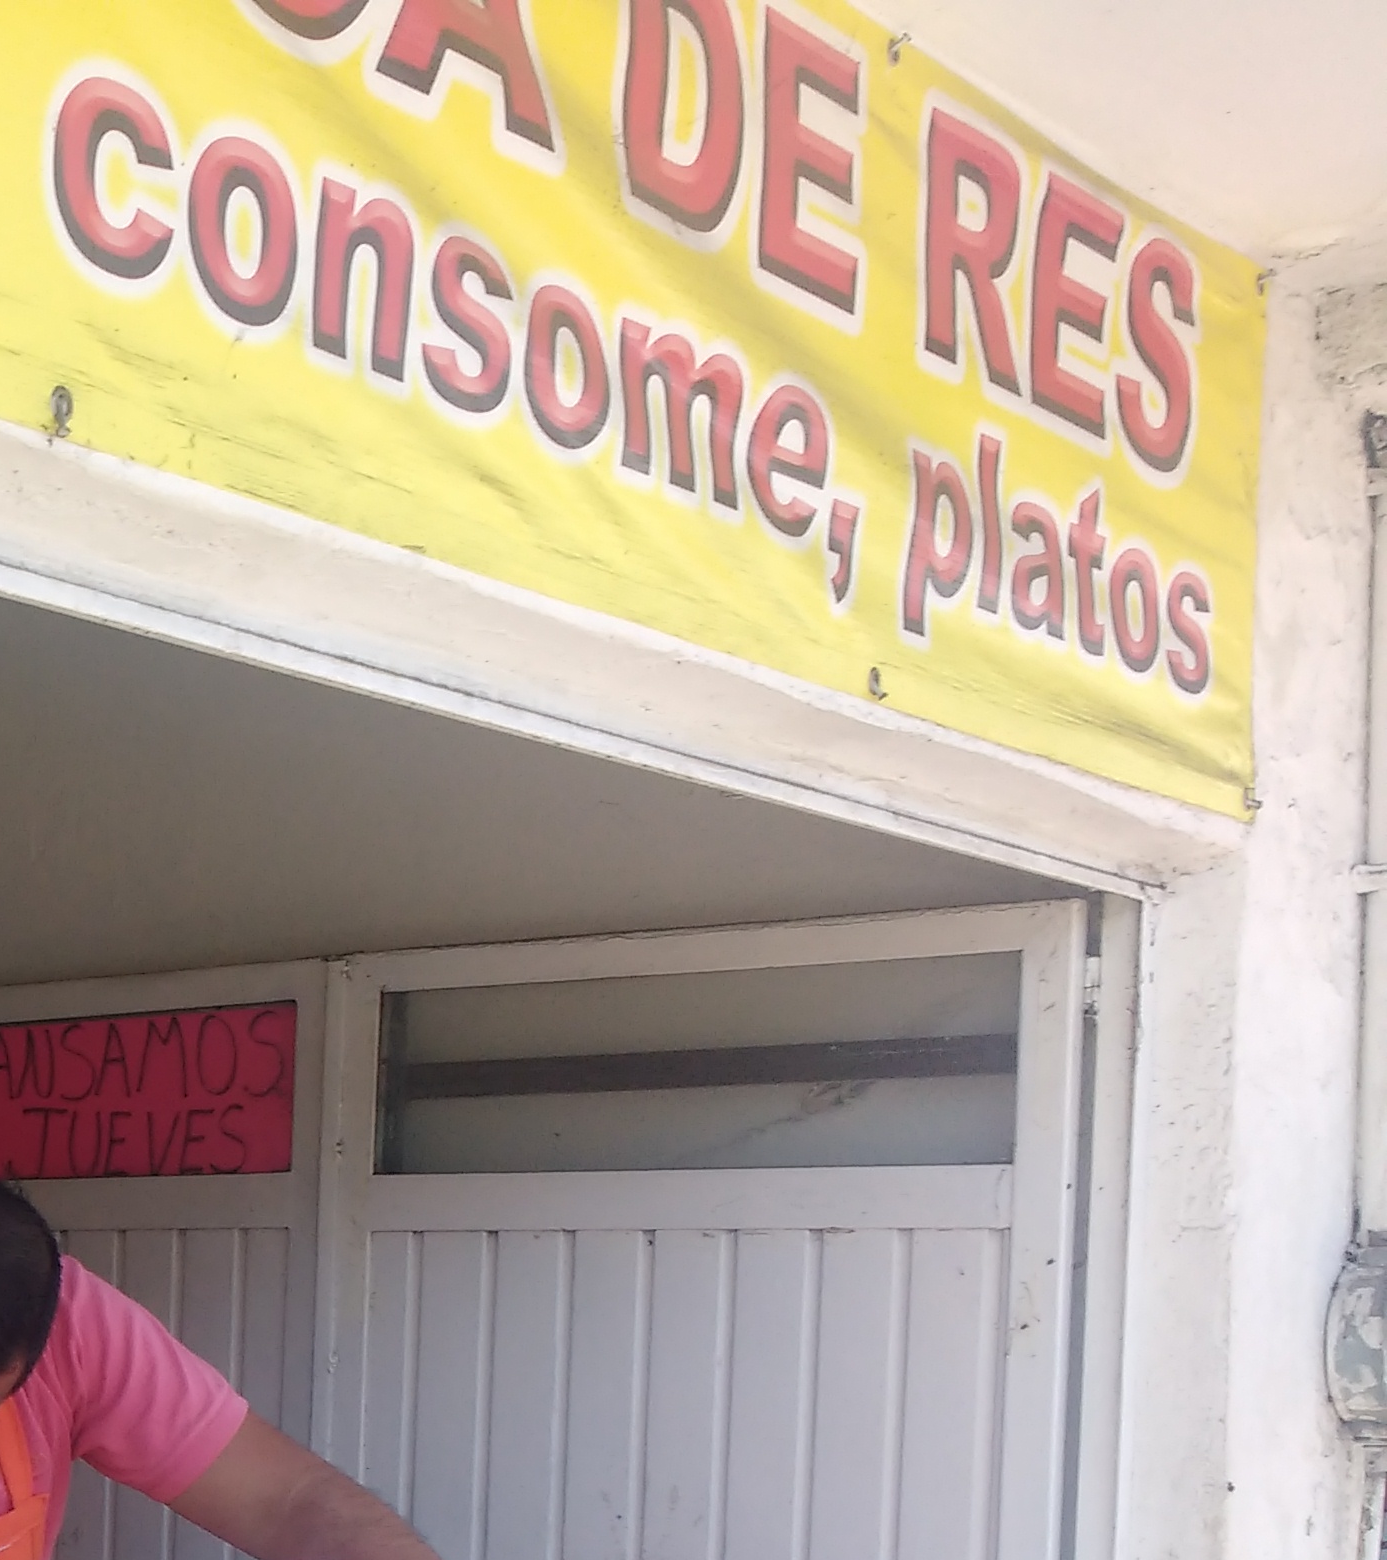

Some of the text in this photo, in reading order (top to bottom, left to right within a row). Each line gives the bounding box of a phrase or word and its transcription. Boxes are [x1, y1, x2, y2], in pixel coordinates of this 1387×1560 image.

[53, 76, 860, 604] consome,
[903, 432, 1211, 696] platos
[620, 0, 861, 314] DE
[922, 106, 1196, 474] RES
